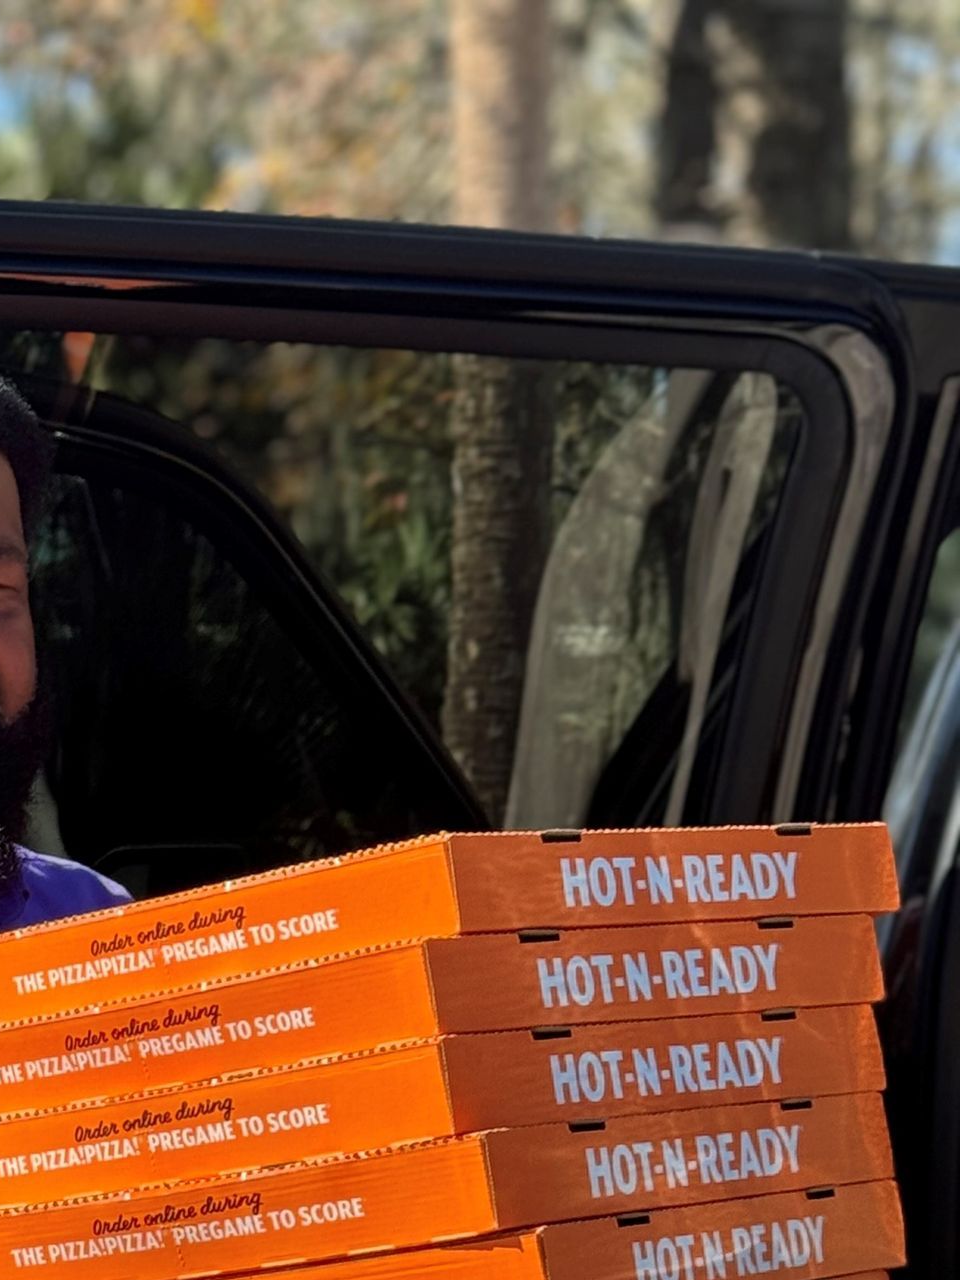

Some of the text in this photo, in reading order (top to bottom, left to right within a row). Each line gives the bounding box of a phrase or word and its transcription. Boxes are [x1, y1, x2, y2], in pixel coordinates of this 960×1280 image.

[560, 852, 797, 907] HOT-N-READY
[14, 972, 46, 992] THE
[161, 929, 247, 963] PREGAME
[249, 924, 274, 944] TO
[278, 910, 337, 939] SCORE
[92, 906, 246, 956] Order online during
[536, 943, 781, 1008] HOT-N-READY
[65, 1005, 221, 1052] Order online during
[139, 1026, 224, 1056] PREGAME
[226, 1021, 251, 1040] TO
[254, 1008, 314, 1036] SCORE
[550, 1037, 782, 1104] HOT-N-READY
[75, 1098, 234, 1142] Order online during
[148, 1120, 235, 1151] PREGAME
[238, 1116, 264, 1136] TO
[267, 1104, 329, 1132] SCORE
[586, 1125, 801, 1198] HOT-N-READY
[12, 1247, 45, 1266] THE
[172, 1214, 265, 1244] PREGAME
[268, 1210, 295, 1229] TO
[299, 1198, 364, 1225] SCORE
[93, 1193, 263, 1237] Order online during
